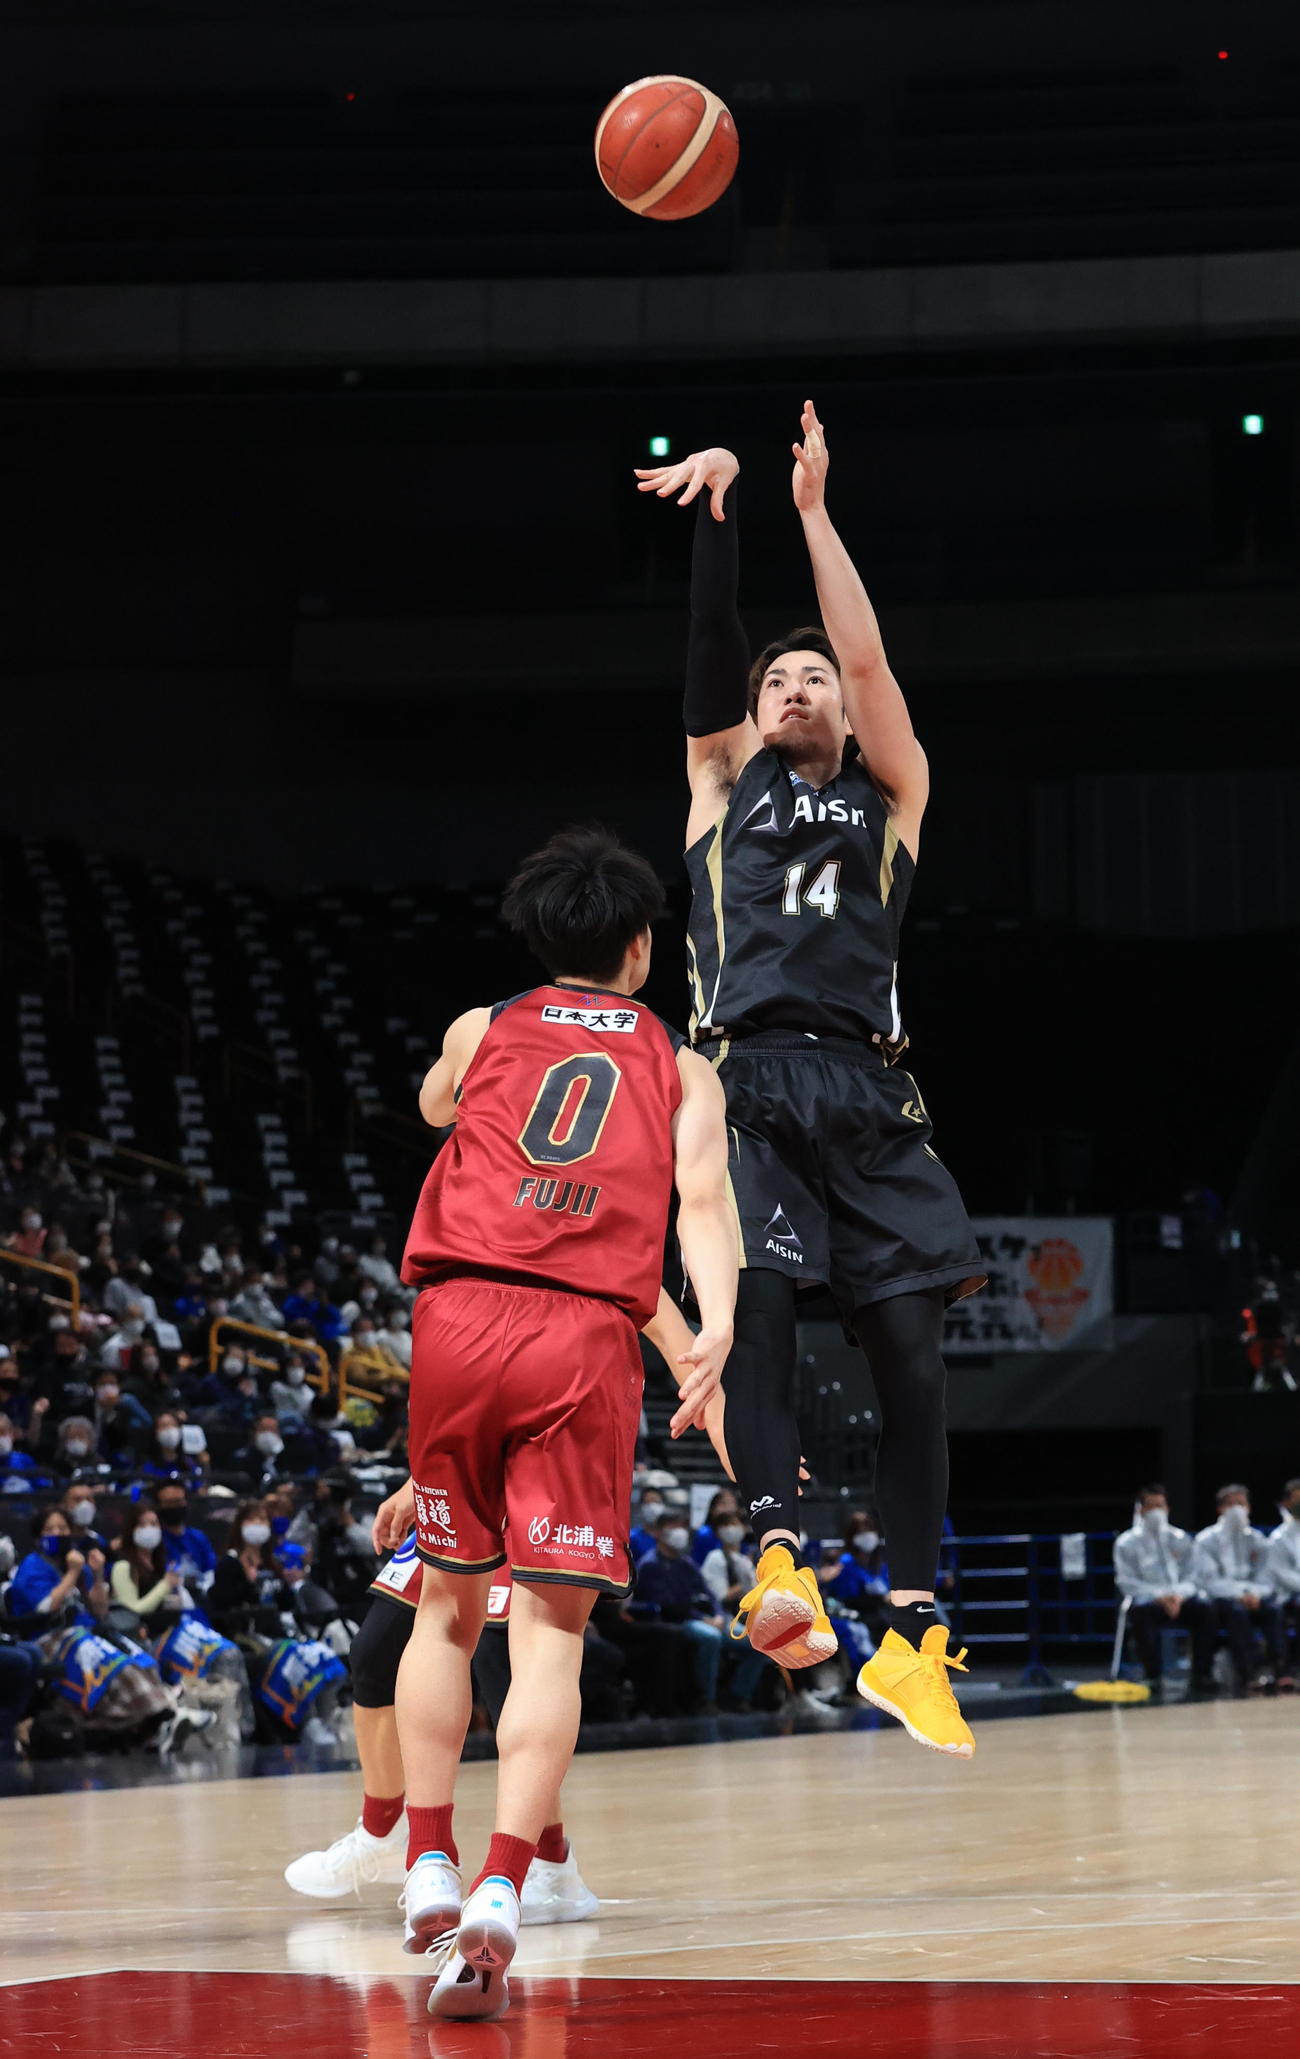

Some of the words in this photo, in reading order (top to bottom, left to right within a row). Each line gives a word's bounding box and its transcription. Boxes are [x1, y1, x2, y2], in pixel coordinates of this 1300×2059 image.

[782, 860, 842, 920] 14
[544, 1007, 636, 1029] 日本大学
[517, 1052, 622, 1167] 0
[512, 1175, 603, 1217] FUJII
[765, 1238, 804, 1265] AISIN
[427, 1532, 457, 1549] Michi
[568, 1549, 595, 1560] KOGYO
